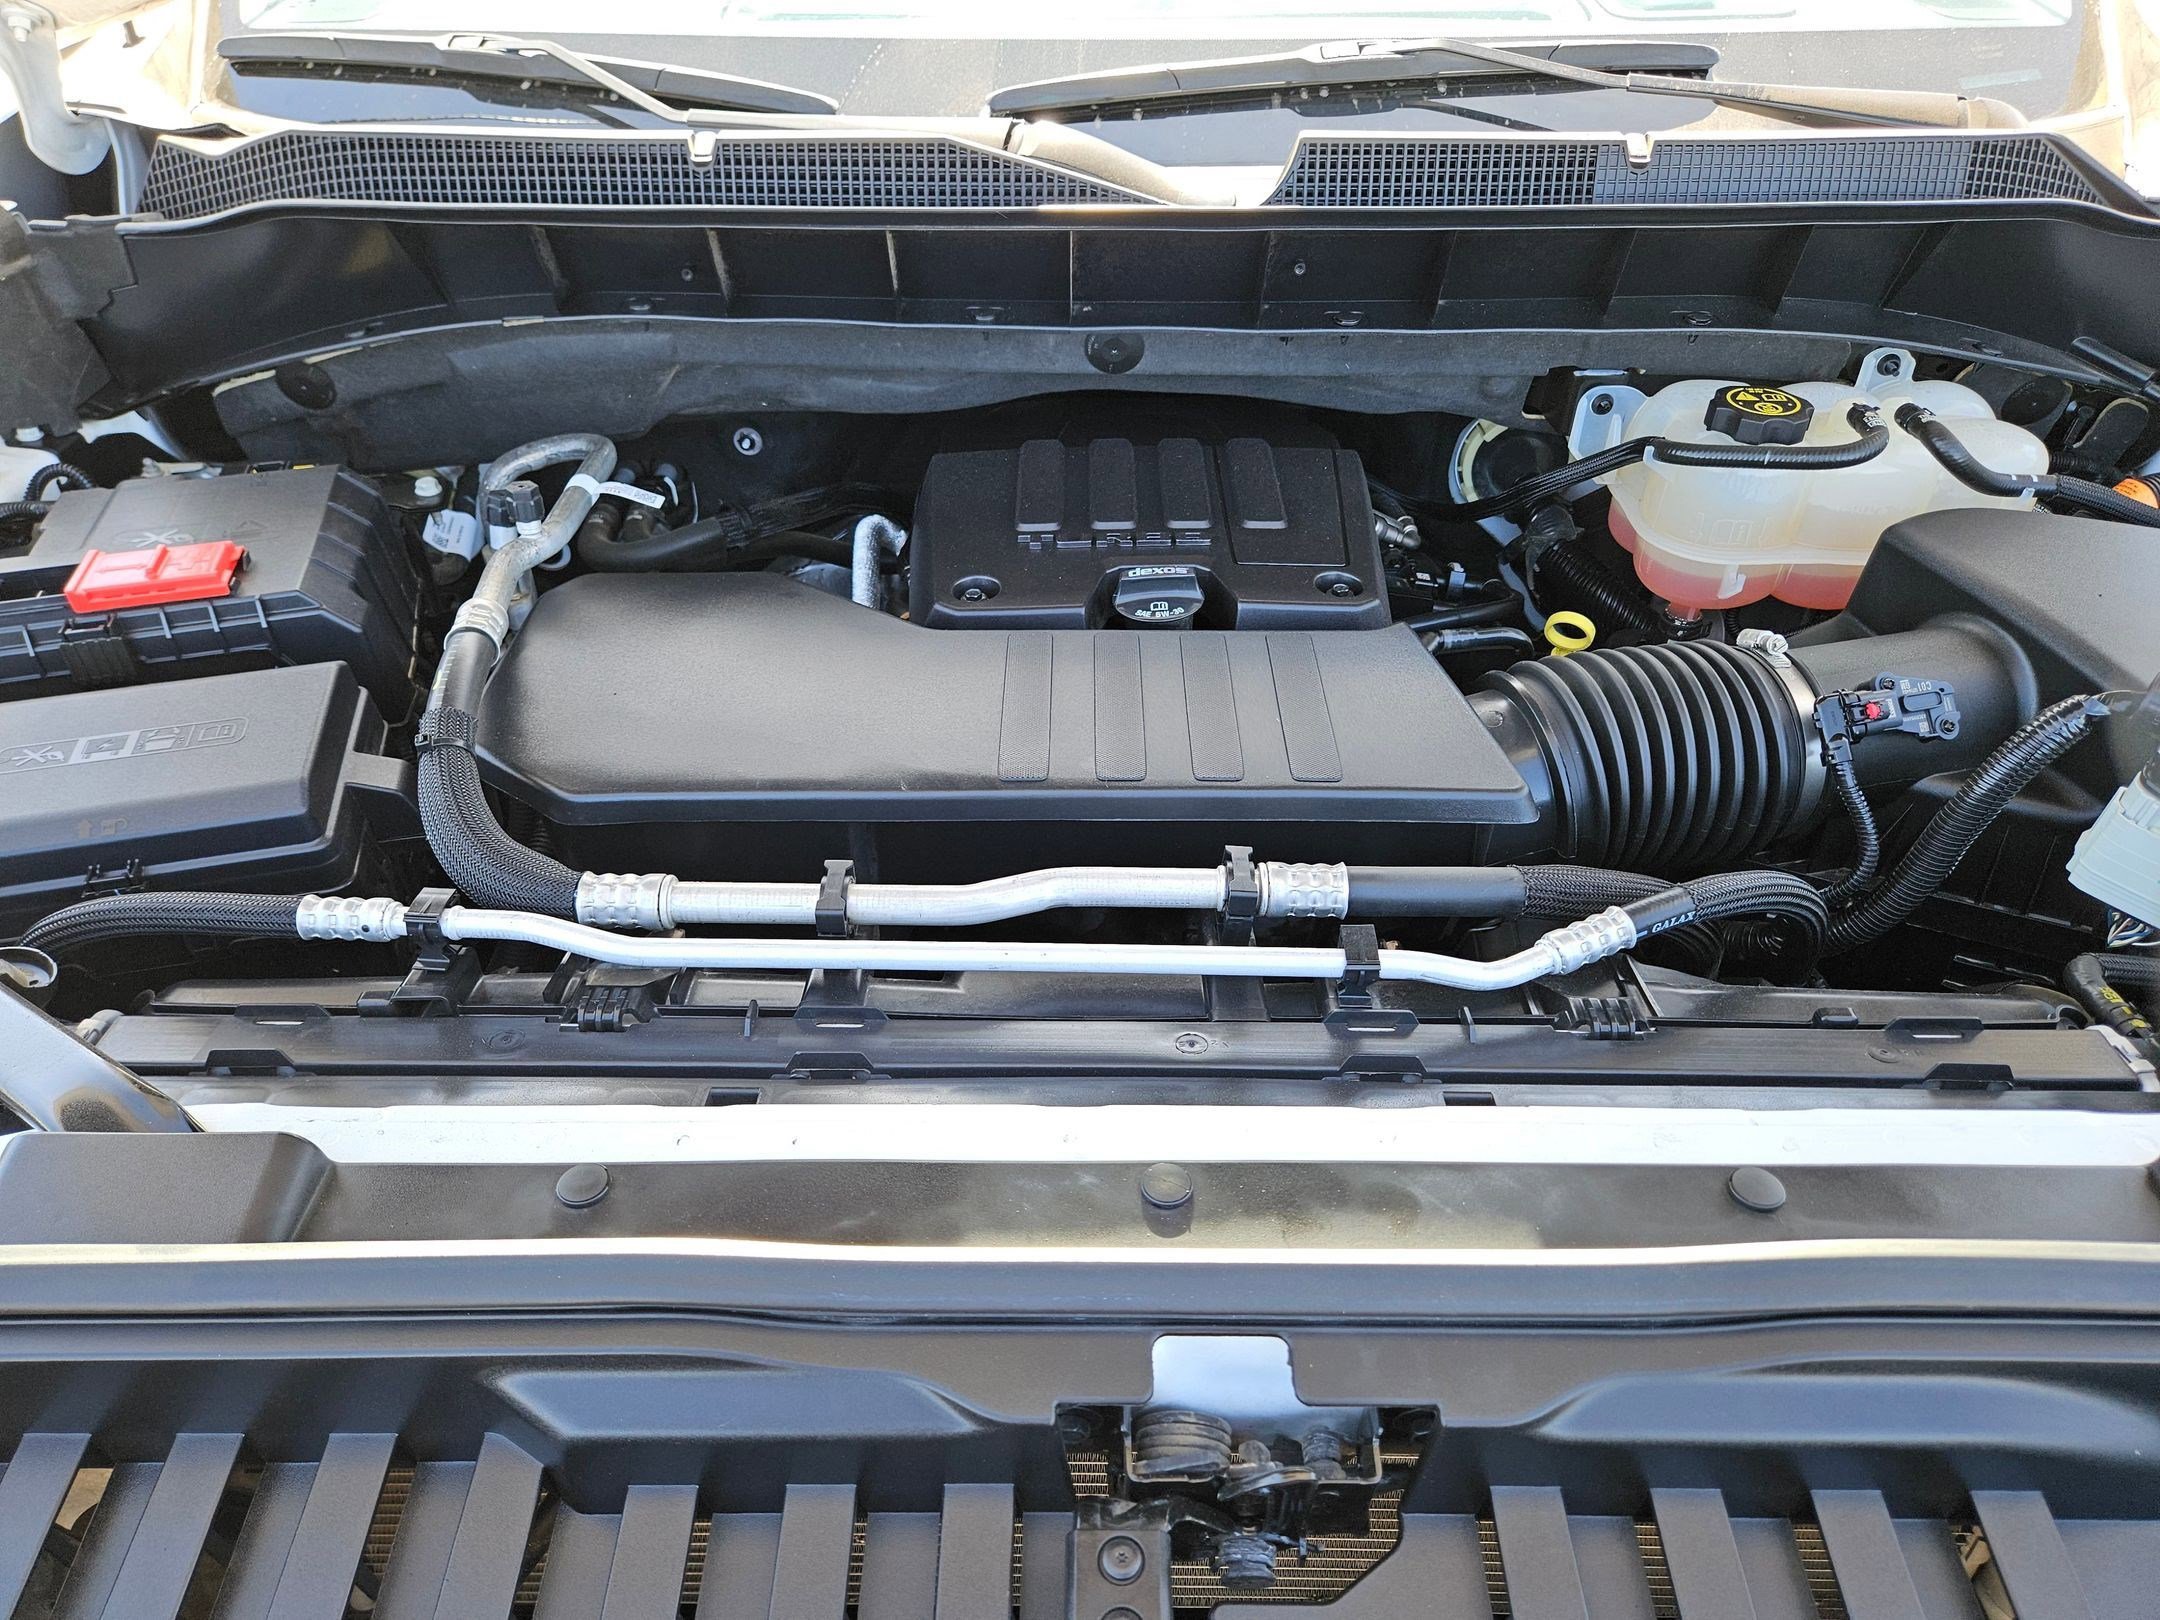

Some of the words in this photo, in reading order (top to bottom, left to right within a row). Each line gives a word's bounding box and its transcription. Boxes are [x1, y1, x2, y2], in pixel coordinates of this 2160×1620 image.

[1128, 566, 1189, 577] dexos
[1135, 609, 1152, 617] SAE
[1155, 607, 1184, 618] 5W-30
